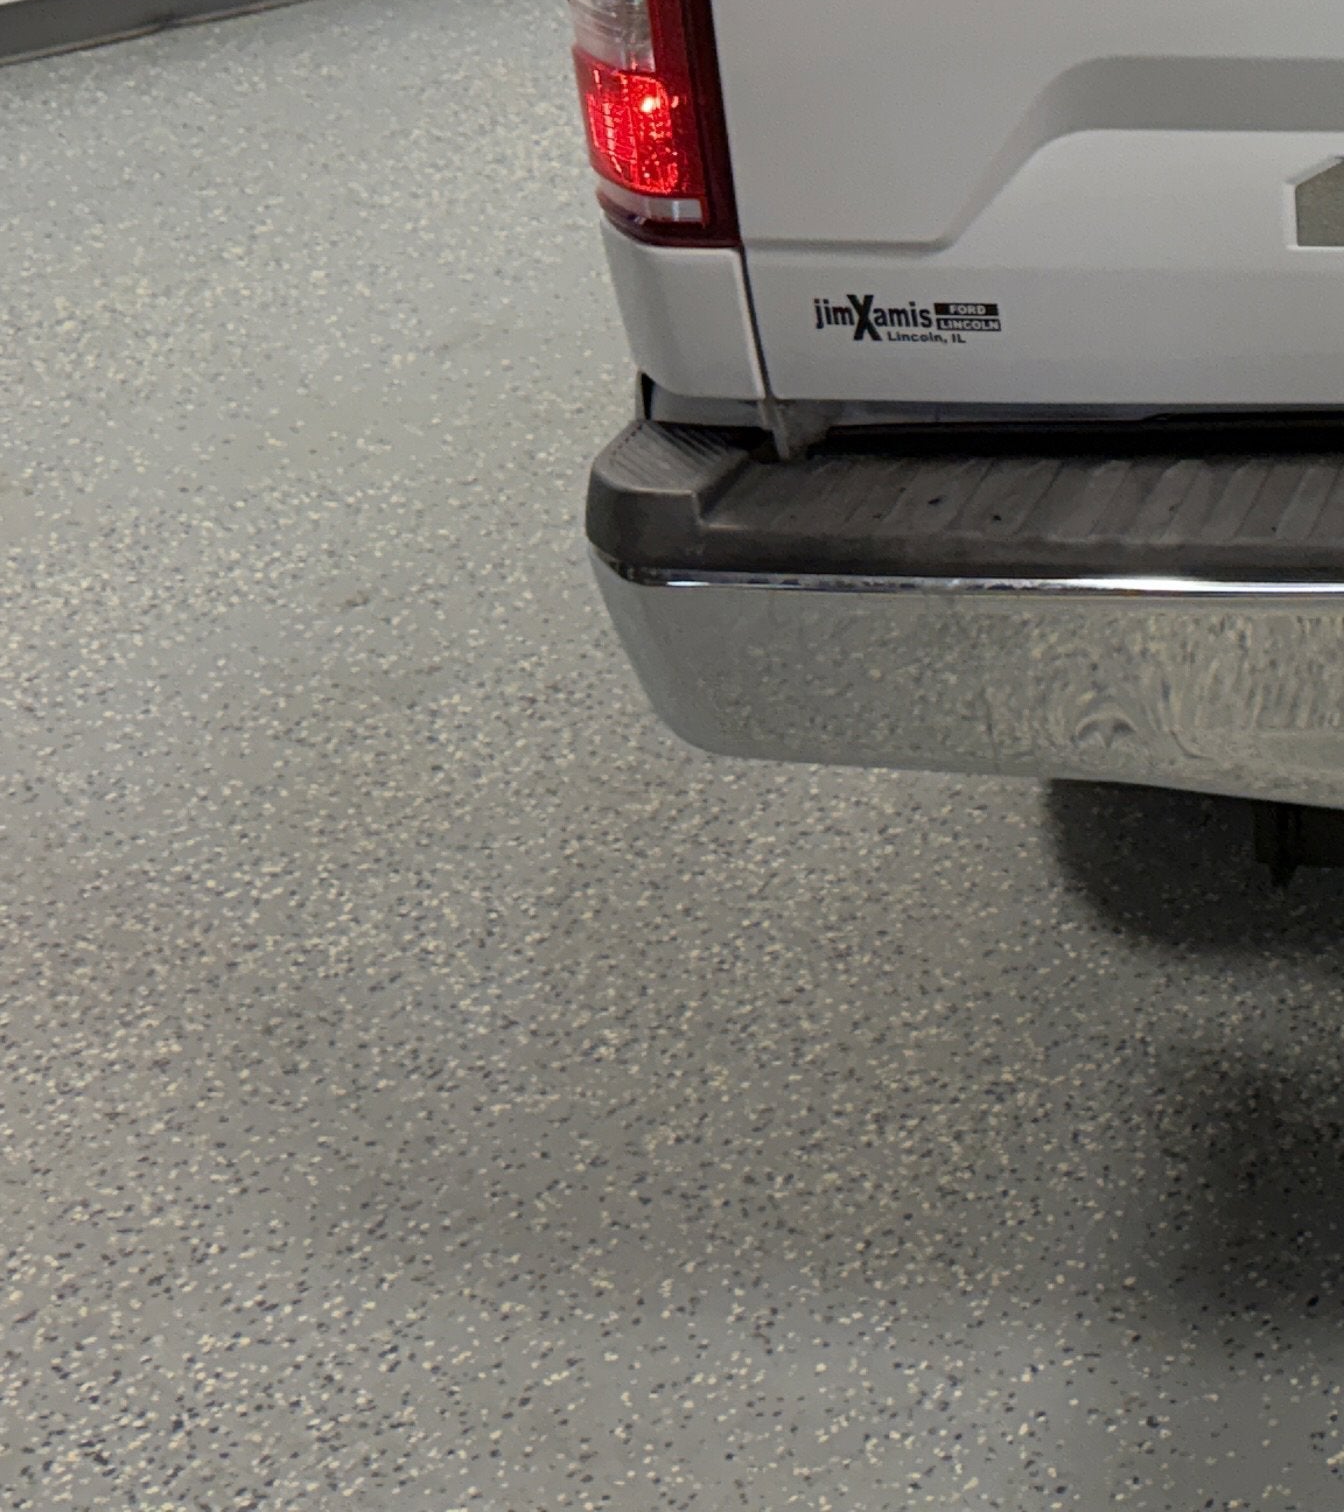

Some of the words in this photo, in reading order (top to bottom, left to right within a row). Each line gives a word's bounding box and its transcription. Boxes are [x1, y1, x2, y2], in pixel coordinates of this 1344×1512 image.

[949, 304, 987, 316] FORD
[939, 319, 1000, 330] LINCOLN
[952, 333, 967, 344] IL
